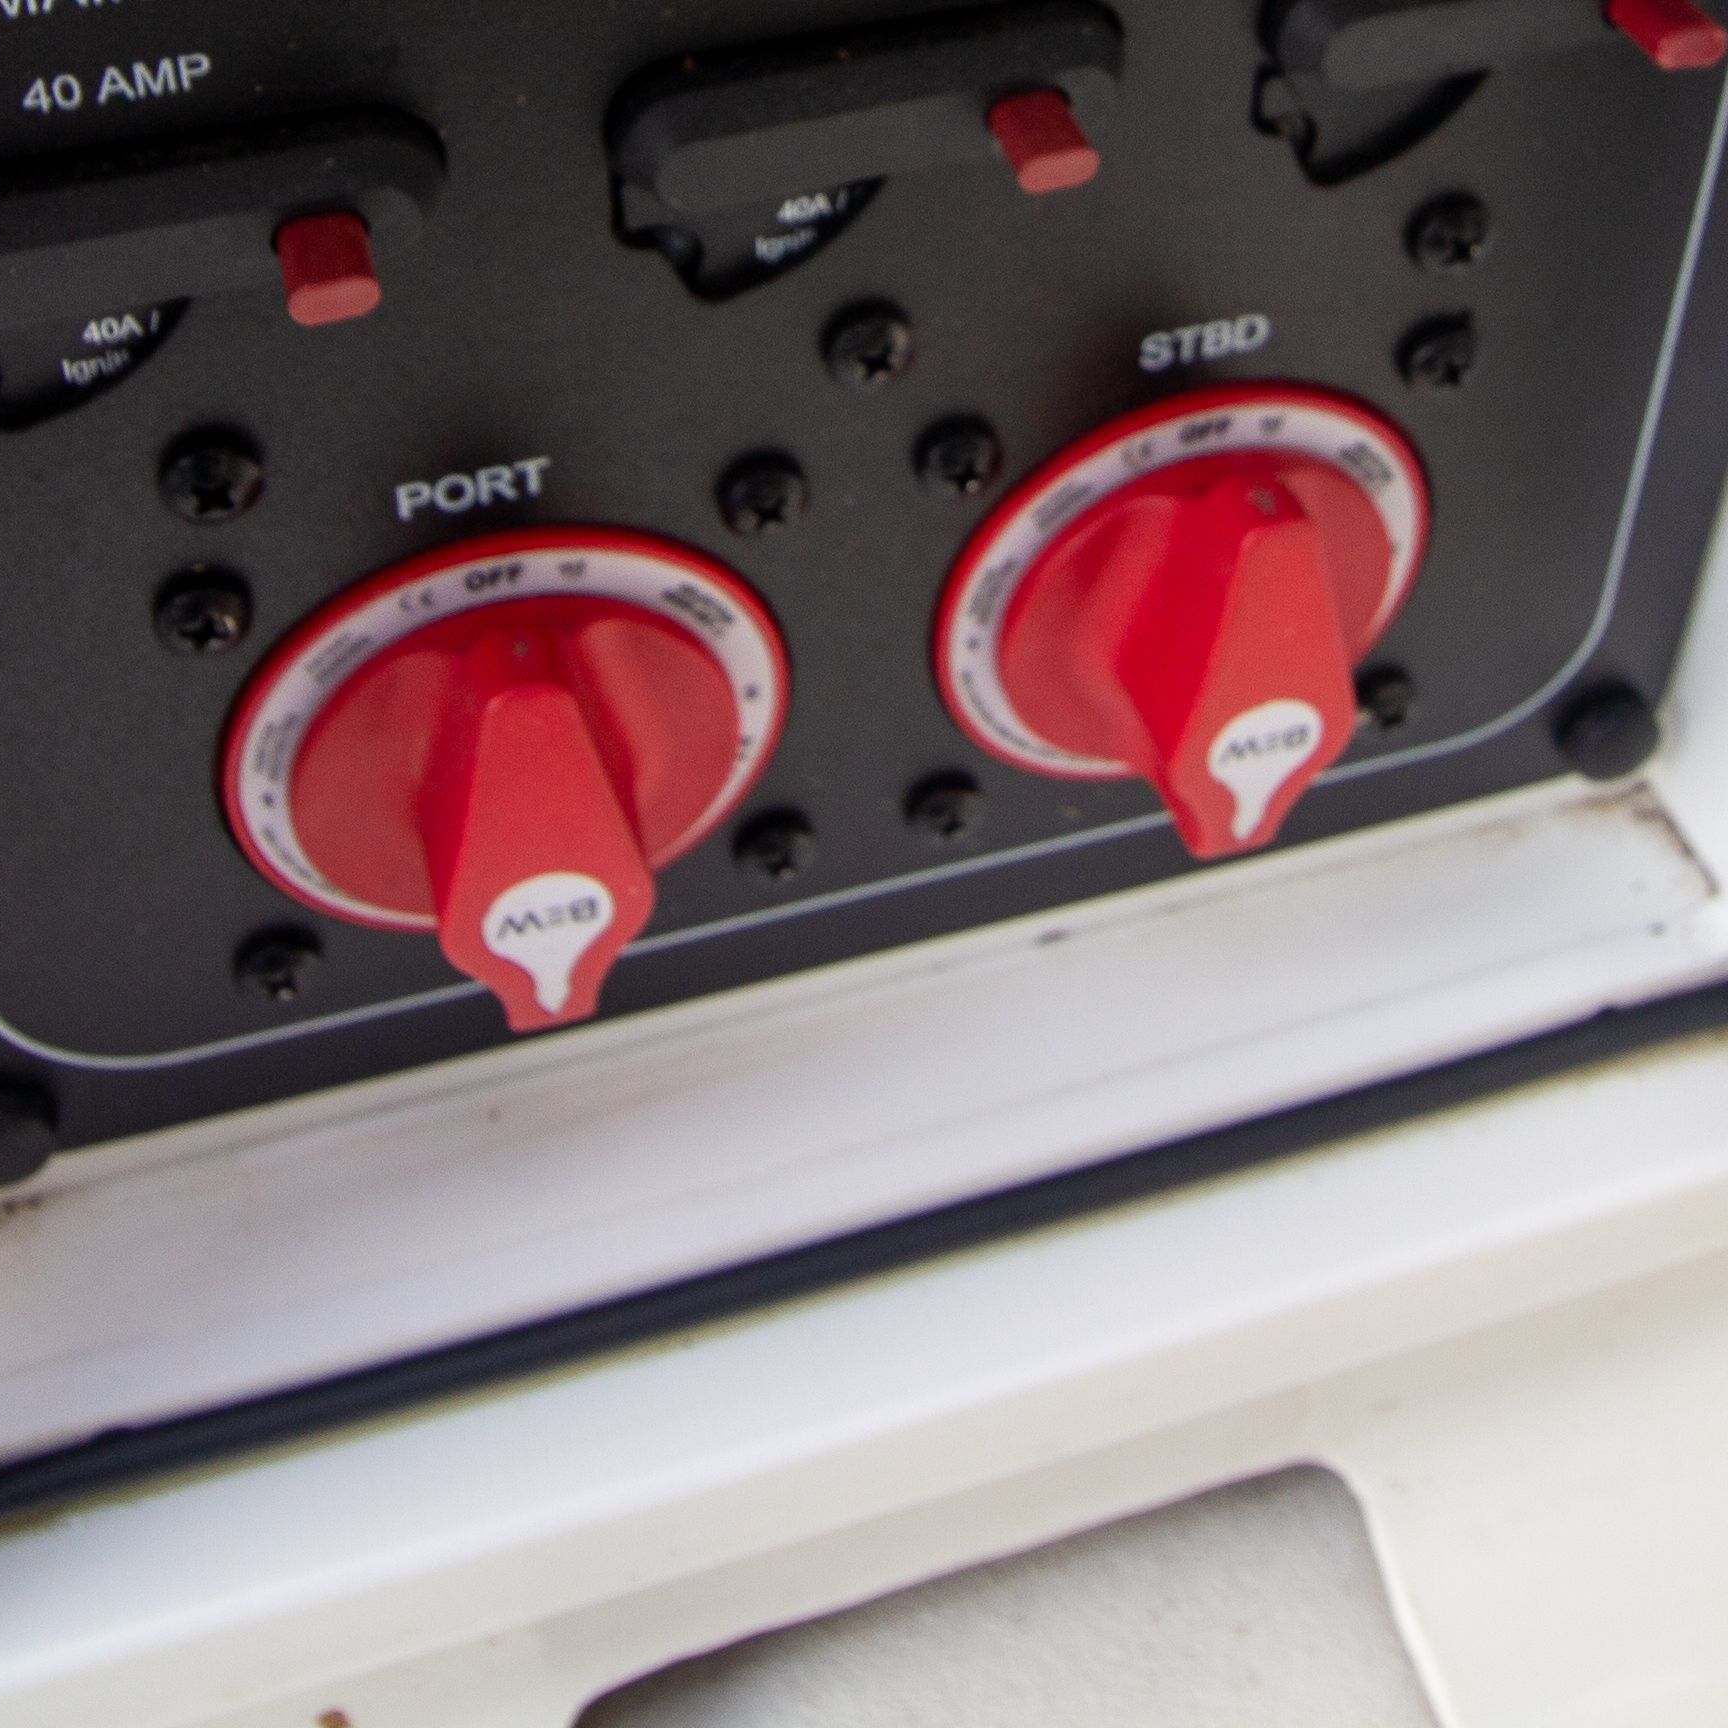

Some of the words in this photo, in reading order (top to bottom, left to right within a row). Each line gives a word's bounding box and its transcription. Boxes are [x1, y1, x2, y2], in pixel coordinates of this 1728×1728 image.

[22, 73, 83, 113] 40
[97, 52, 211, 104] AMP
[82, 313, 143, 345] 40A
[1140, 311, 1273, 369] STBD
[394, 455, 552, 522] PORT
